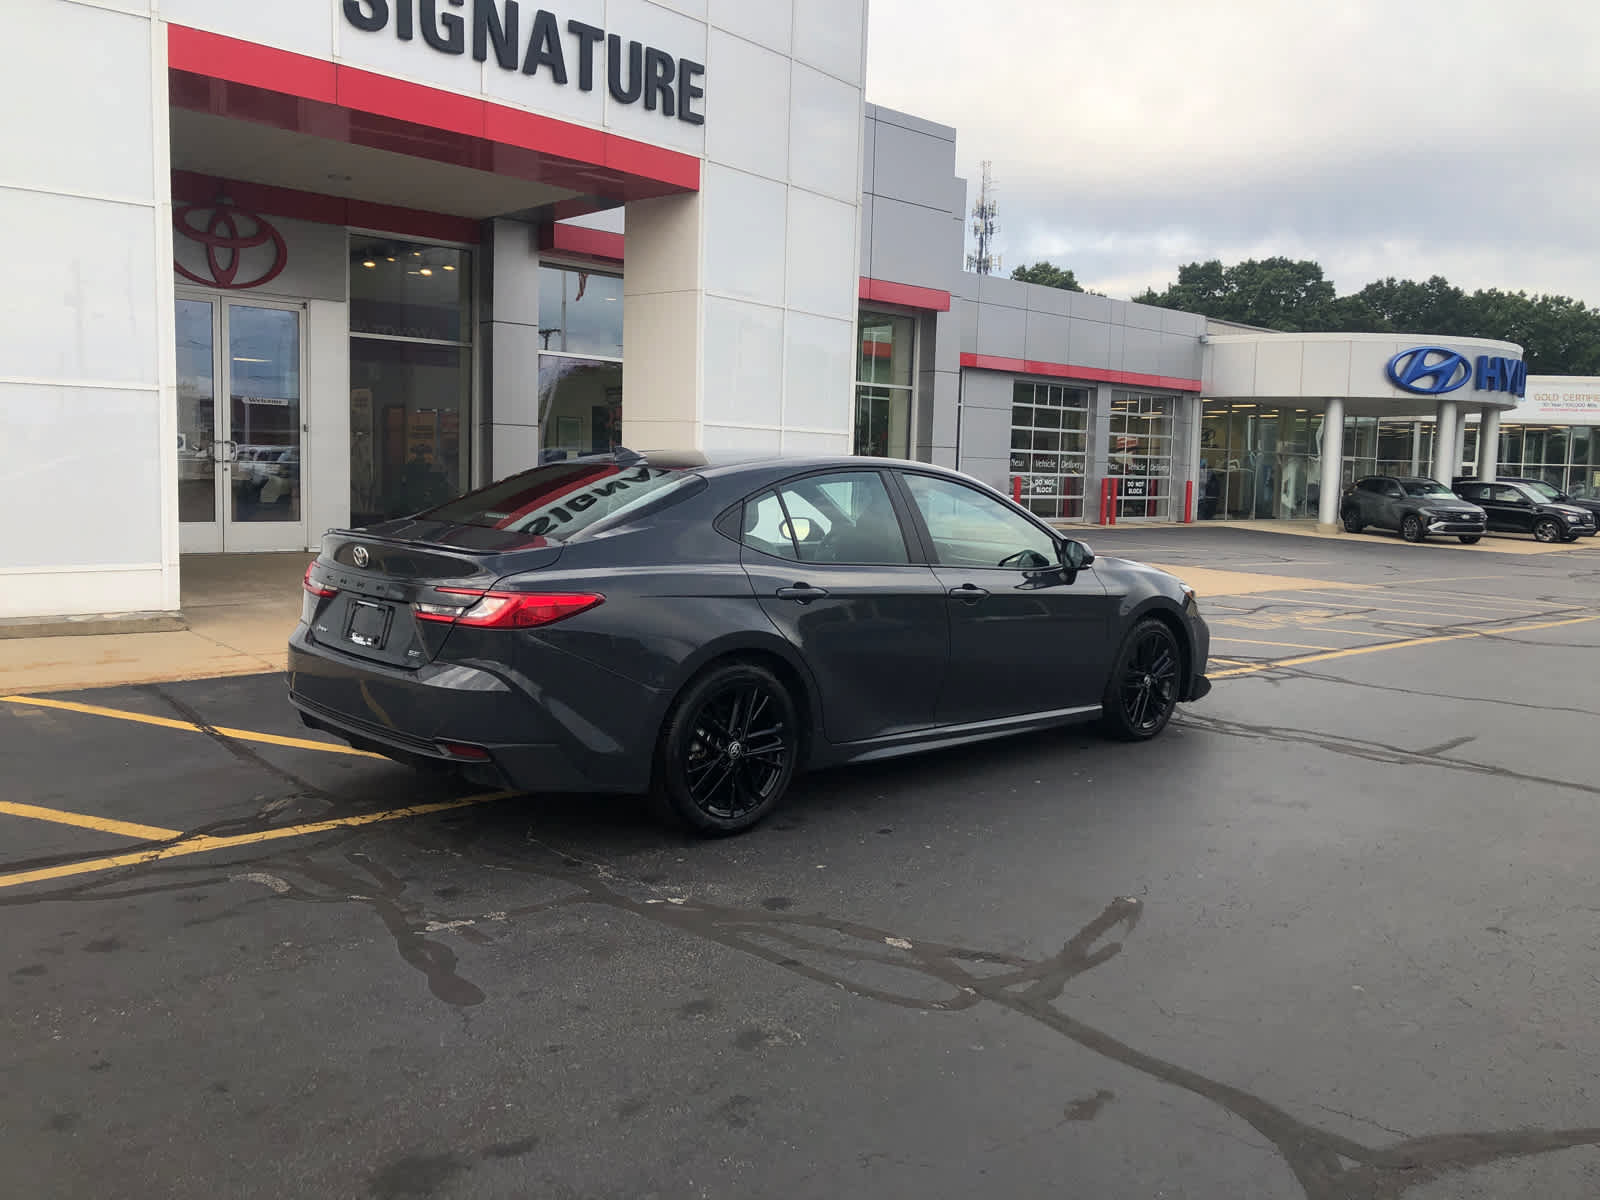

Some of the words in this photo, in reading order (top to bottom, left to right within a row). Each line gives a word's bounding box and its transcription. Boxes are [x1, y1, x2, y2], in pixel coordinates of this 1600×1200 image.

[1534, 392, 1560, 402] GOLD
[1035, 458, 1057, 468] Vehicle
[1061, 460, 1084, 470] Delivery
